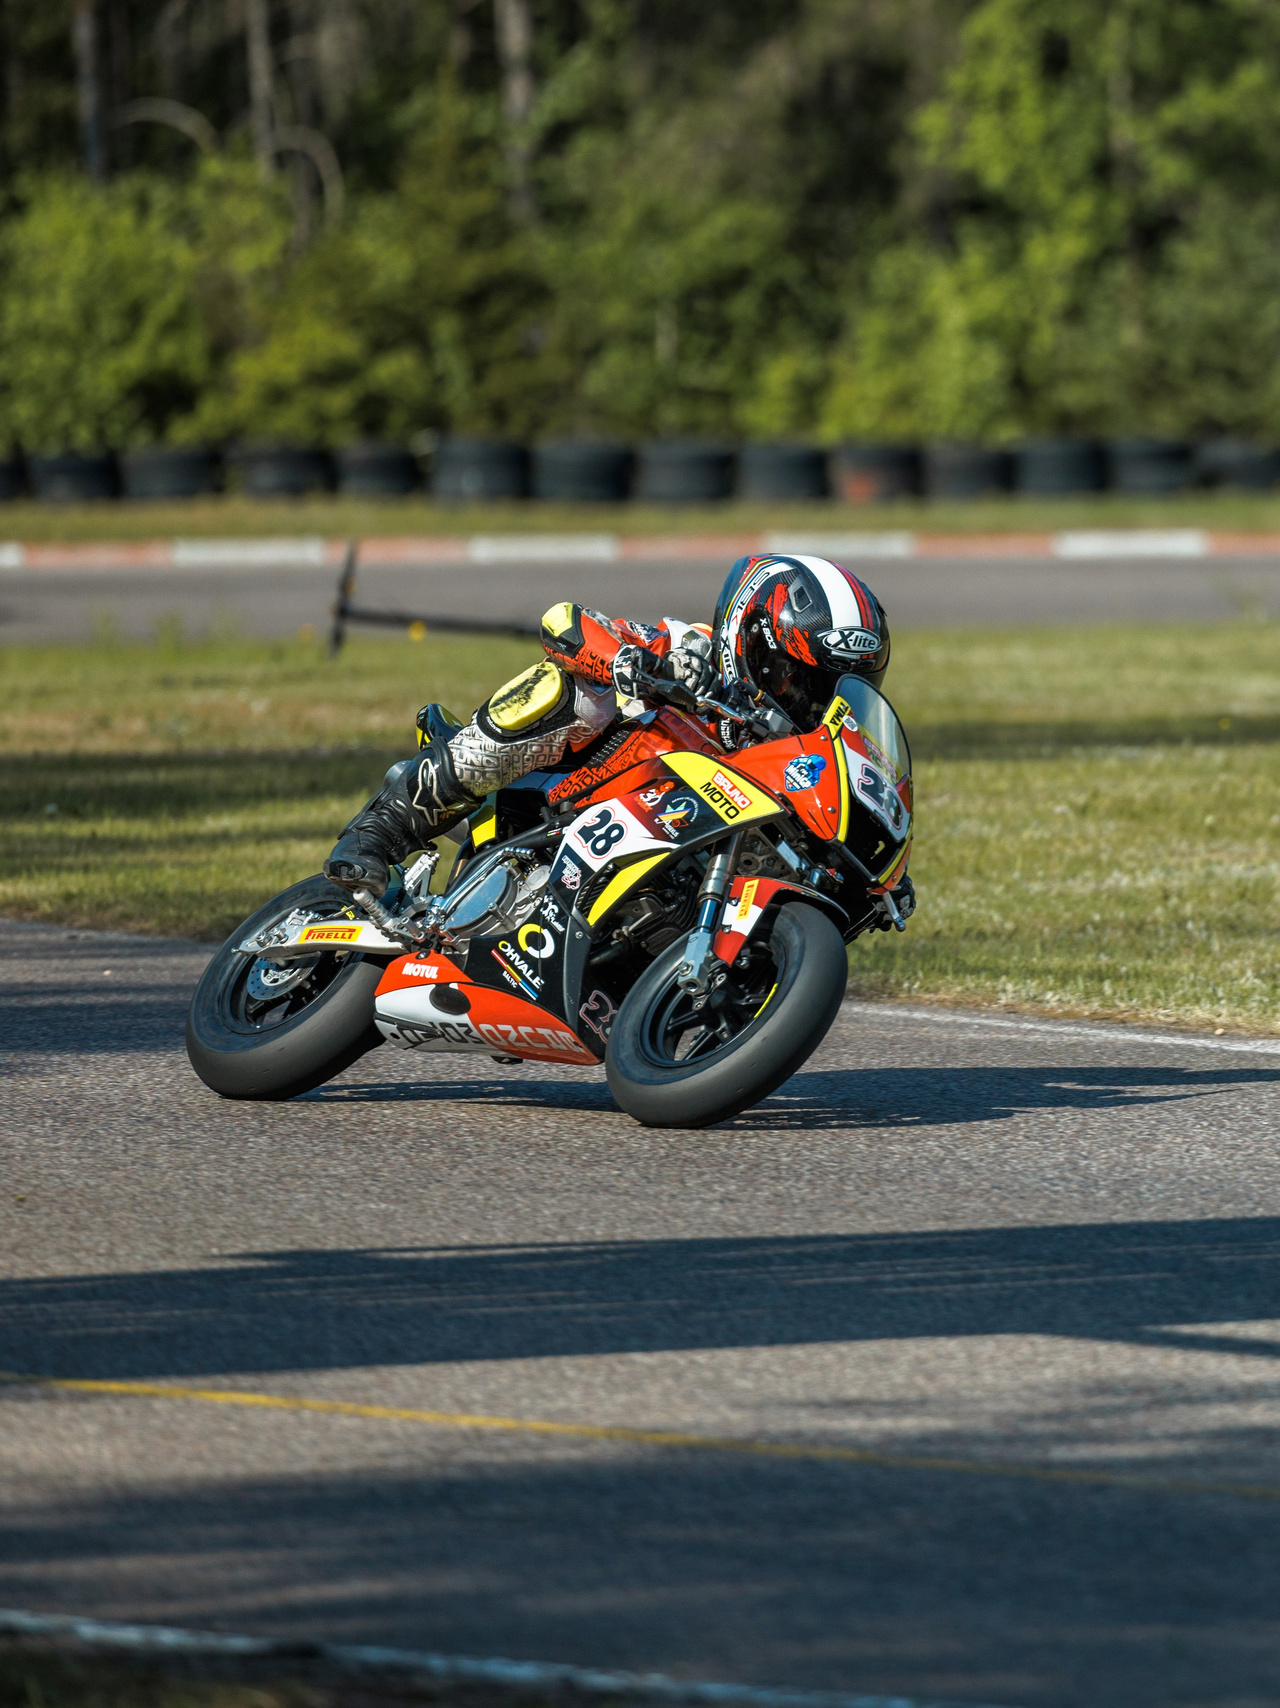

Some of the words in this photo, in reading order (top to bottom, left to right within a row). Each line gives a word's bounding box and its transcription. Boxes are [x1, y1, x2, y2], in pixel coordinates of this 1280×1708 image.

[759, 617, 777, 650] X-803
[832, 630, 876, 650] X-lite
[829, 701, 850, 727] TIMA
[711, 771, 751, 809] BRUNO
[785, 763, 812, 788] MiniGP
[699, 781, 740, 820] MOTO
[576, 808, 625, 857] 28
[739, 884, 754, 918] PIRELLI
[304, 928, 356, 940] PIRELLI
[402, 962, 438, 979] MOTUL
[498, 940, 545, 989] OHVALE
[502, 970, 518, 988] BALTIC
